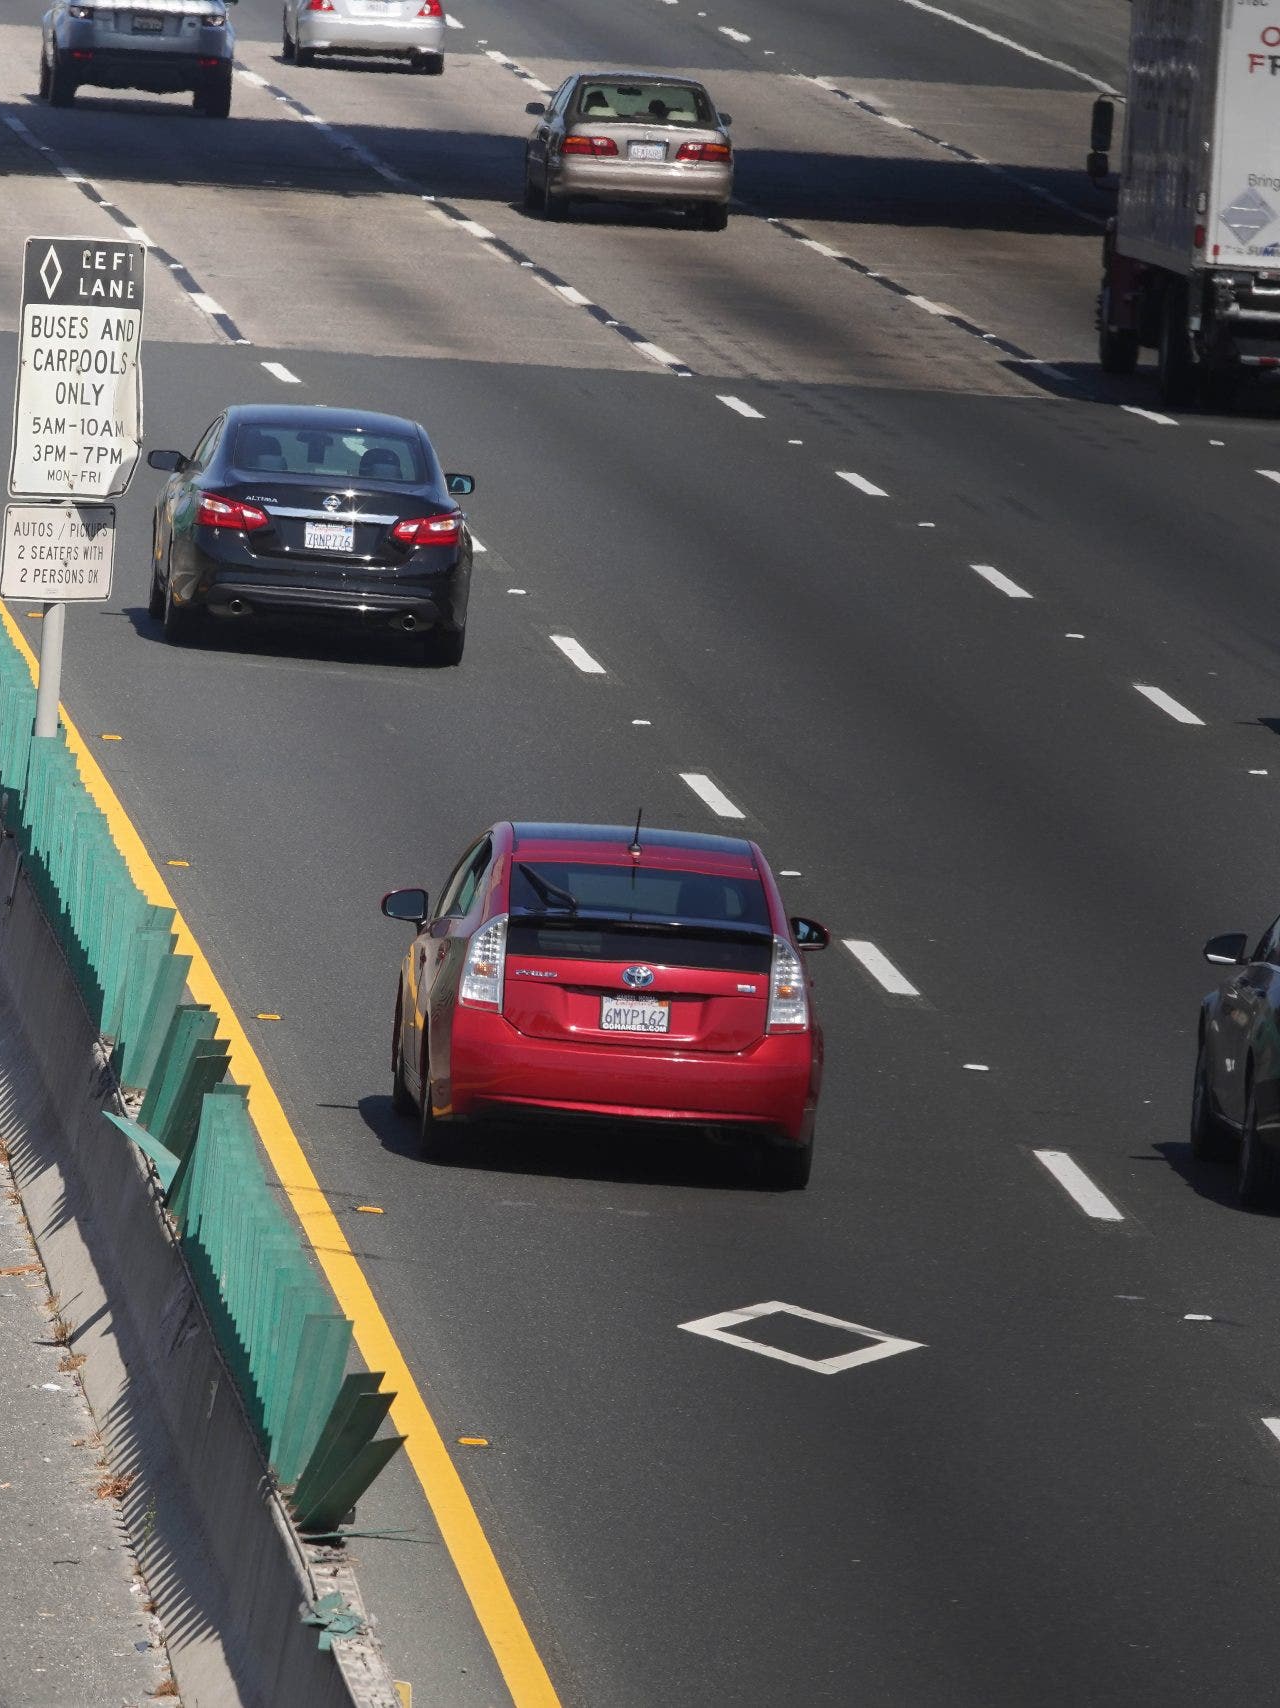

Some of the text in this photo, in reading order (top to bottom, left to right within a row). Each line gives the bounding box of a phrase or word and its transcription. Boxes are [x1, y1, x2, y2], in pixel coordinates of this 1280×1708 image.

[82, 249, 134, 272] LEFT
[79, 277, 135, 299] LANE
[31, 315, 134, 342] BUSES AND
[33, 347, 127, 375] CARPOOLS
[55, 381, 105, 406] ONLY
[32, 416, 125, 438] 5AM-10AM
[47, 469, 101, 483] MON-FRI
[245, 495, 279, 503] ALTIMA
[13, 522, 53, 538] AUTOS
[69, 522, 108, 538] PICKUPS
[17, 545, 104, 561] 2 SEATERS WITH
[20, 567, 99, 584] 2 PERSONS OK
[605, 1007, 666, 1027] 6MYP162
